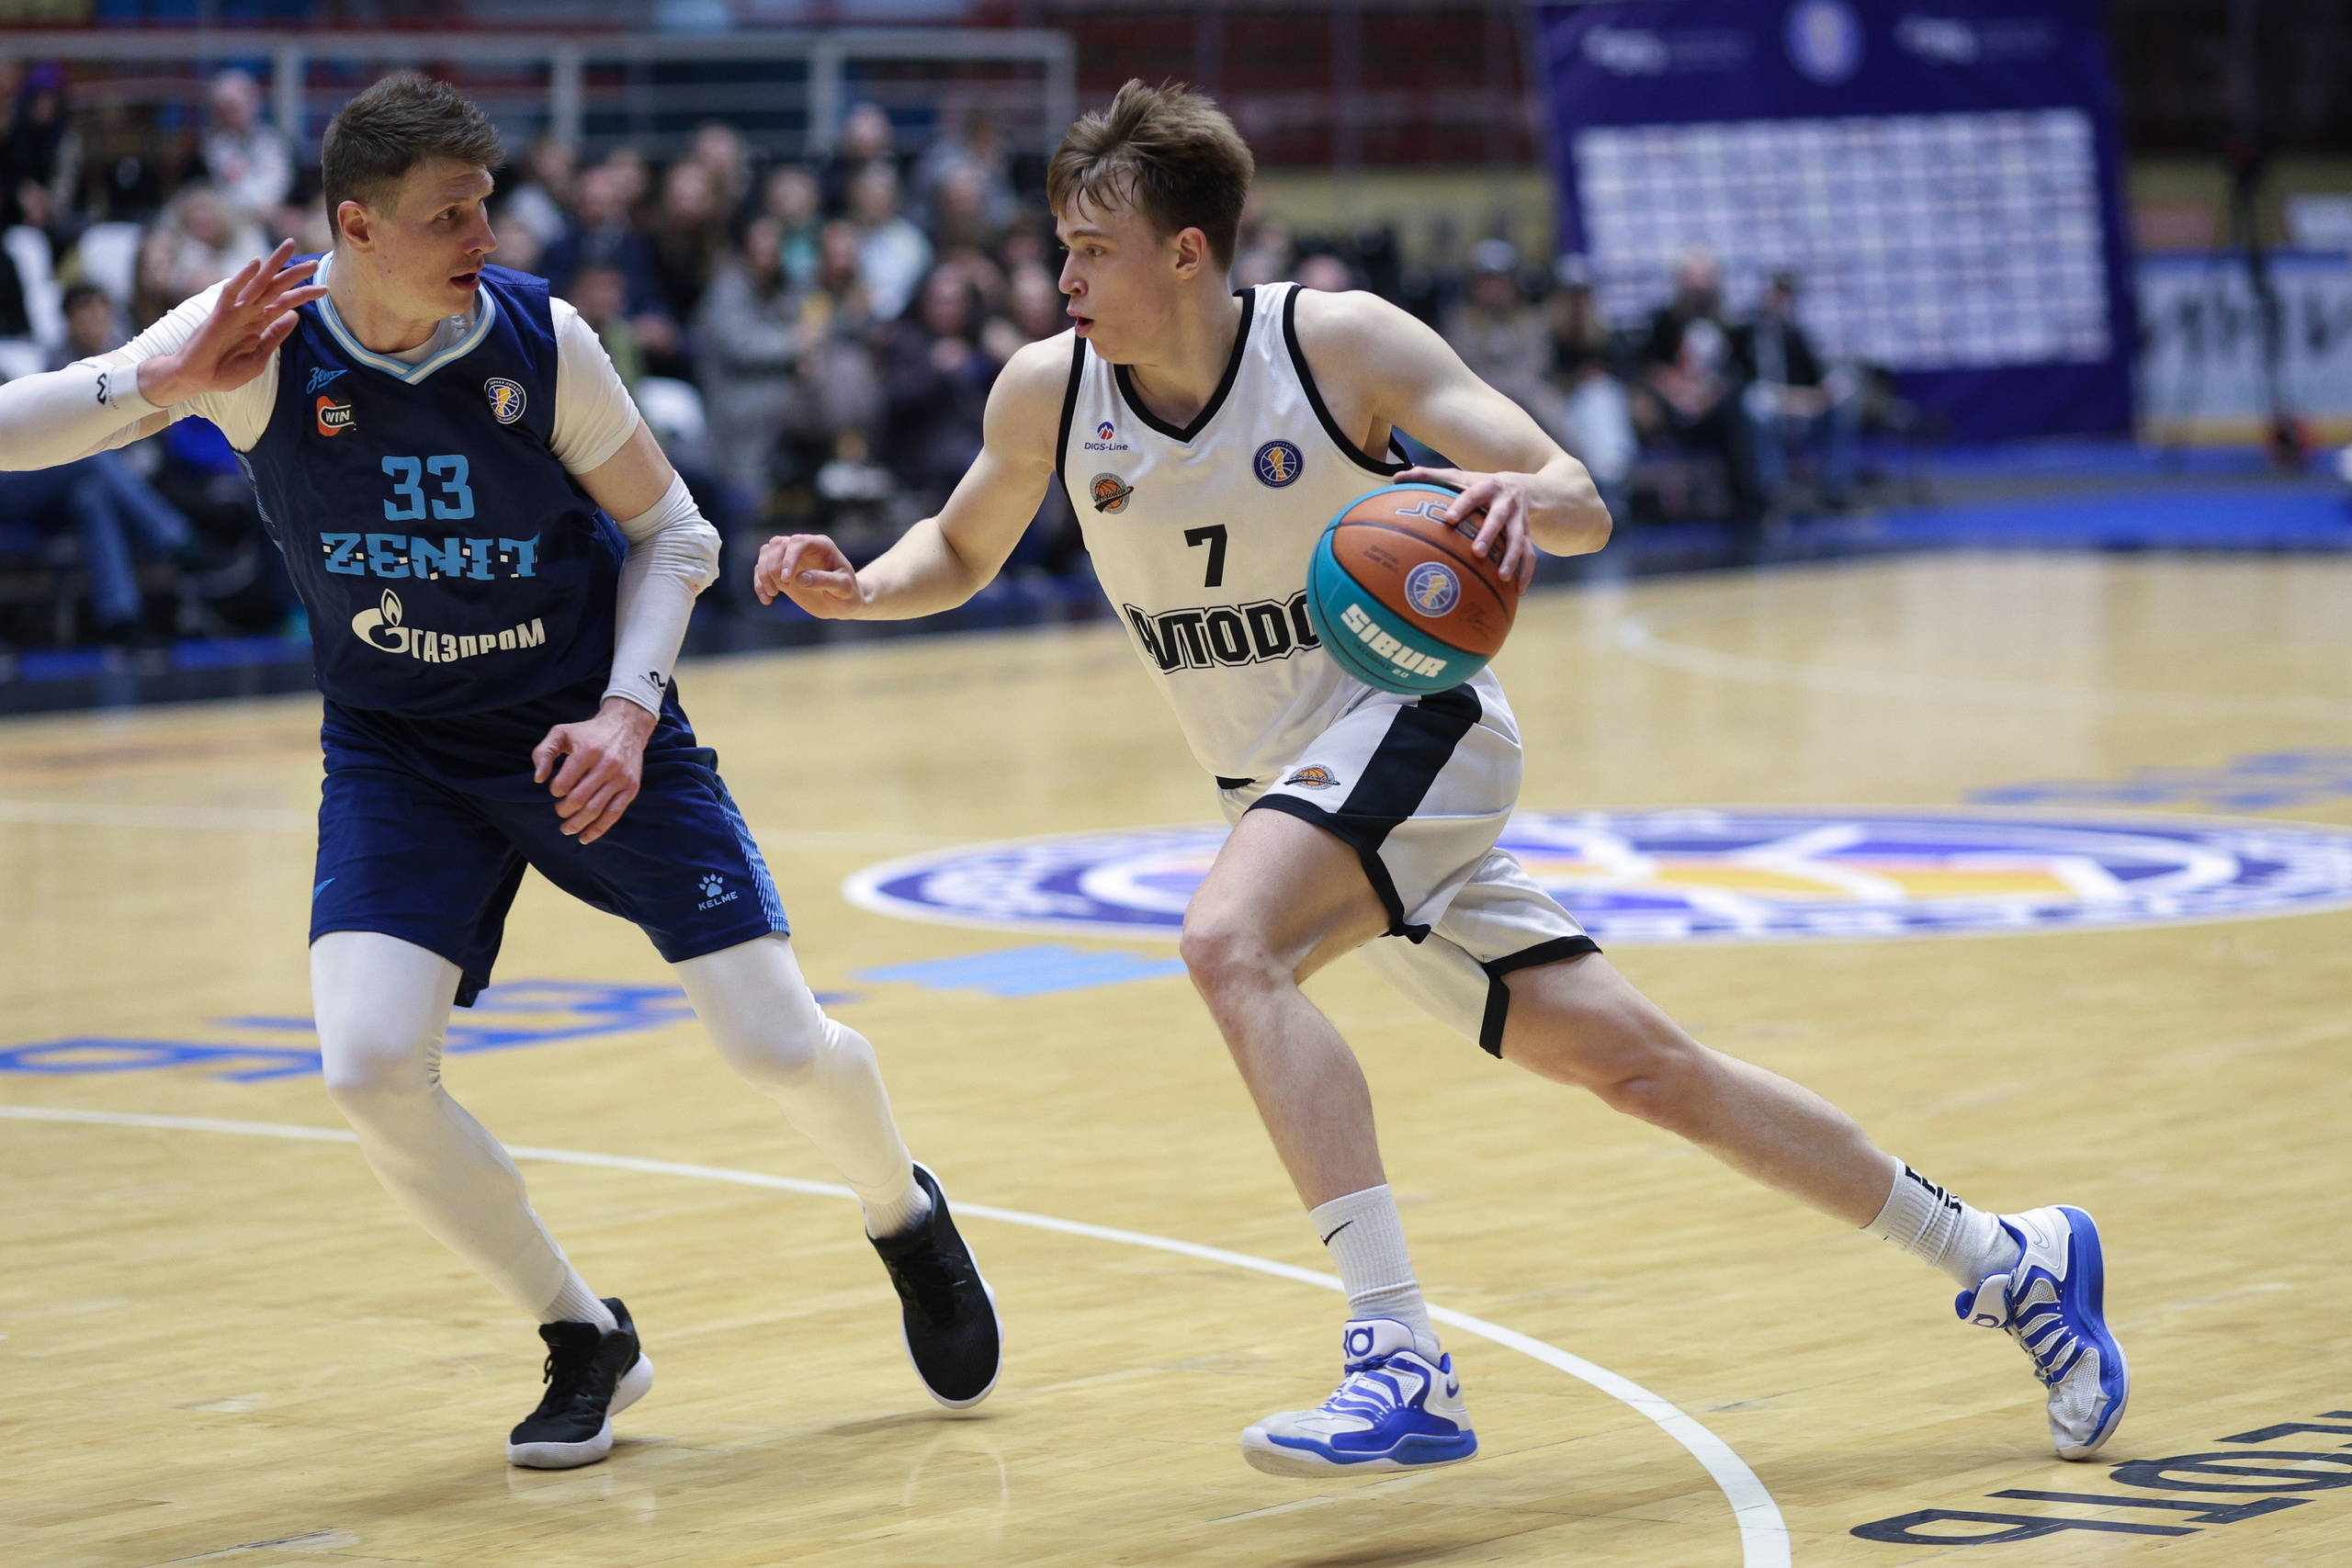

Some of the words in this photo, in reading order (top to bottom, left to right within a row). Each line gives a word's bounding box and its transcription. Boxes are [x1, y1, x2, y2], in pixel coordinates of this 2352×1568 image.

[1084, 442, 1128, 451] DIGS-Line
[381, 455, 475, 521] 33
[320, 530, 541, 581] ZENIT
[1183, 524, 1228, 588] 7
[411, 617, 547, 664] ГАЗПРОМ
[1123, 589, 1322, 674] AVTODO
[1340, 603, 1448, 678] SIBUR
[698, 891, 738, 911] KELME
